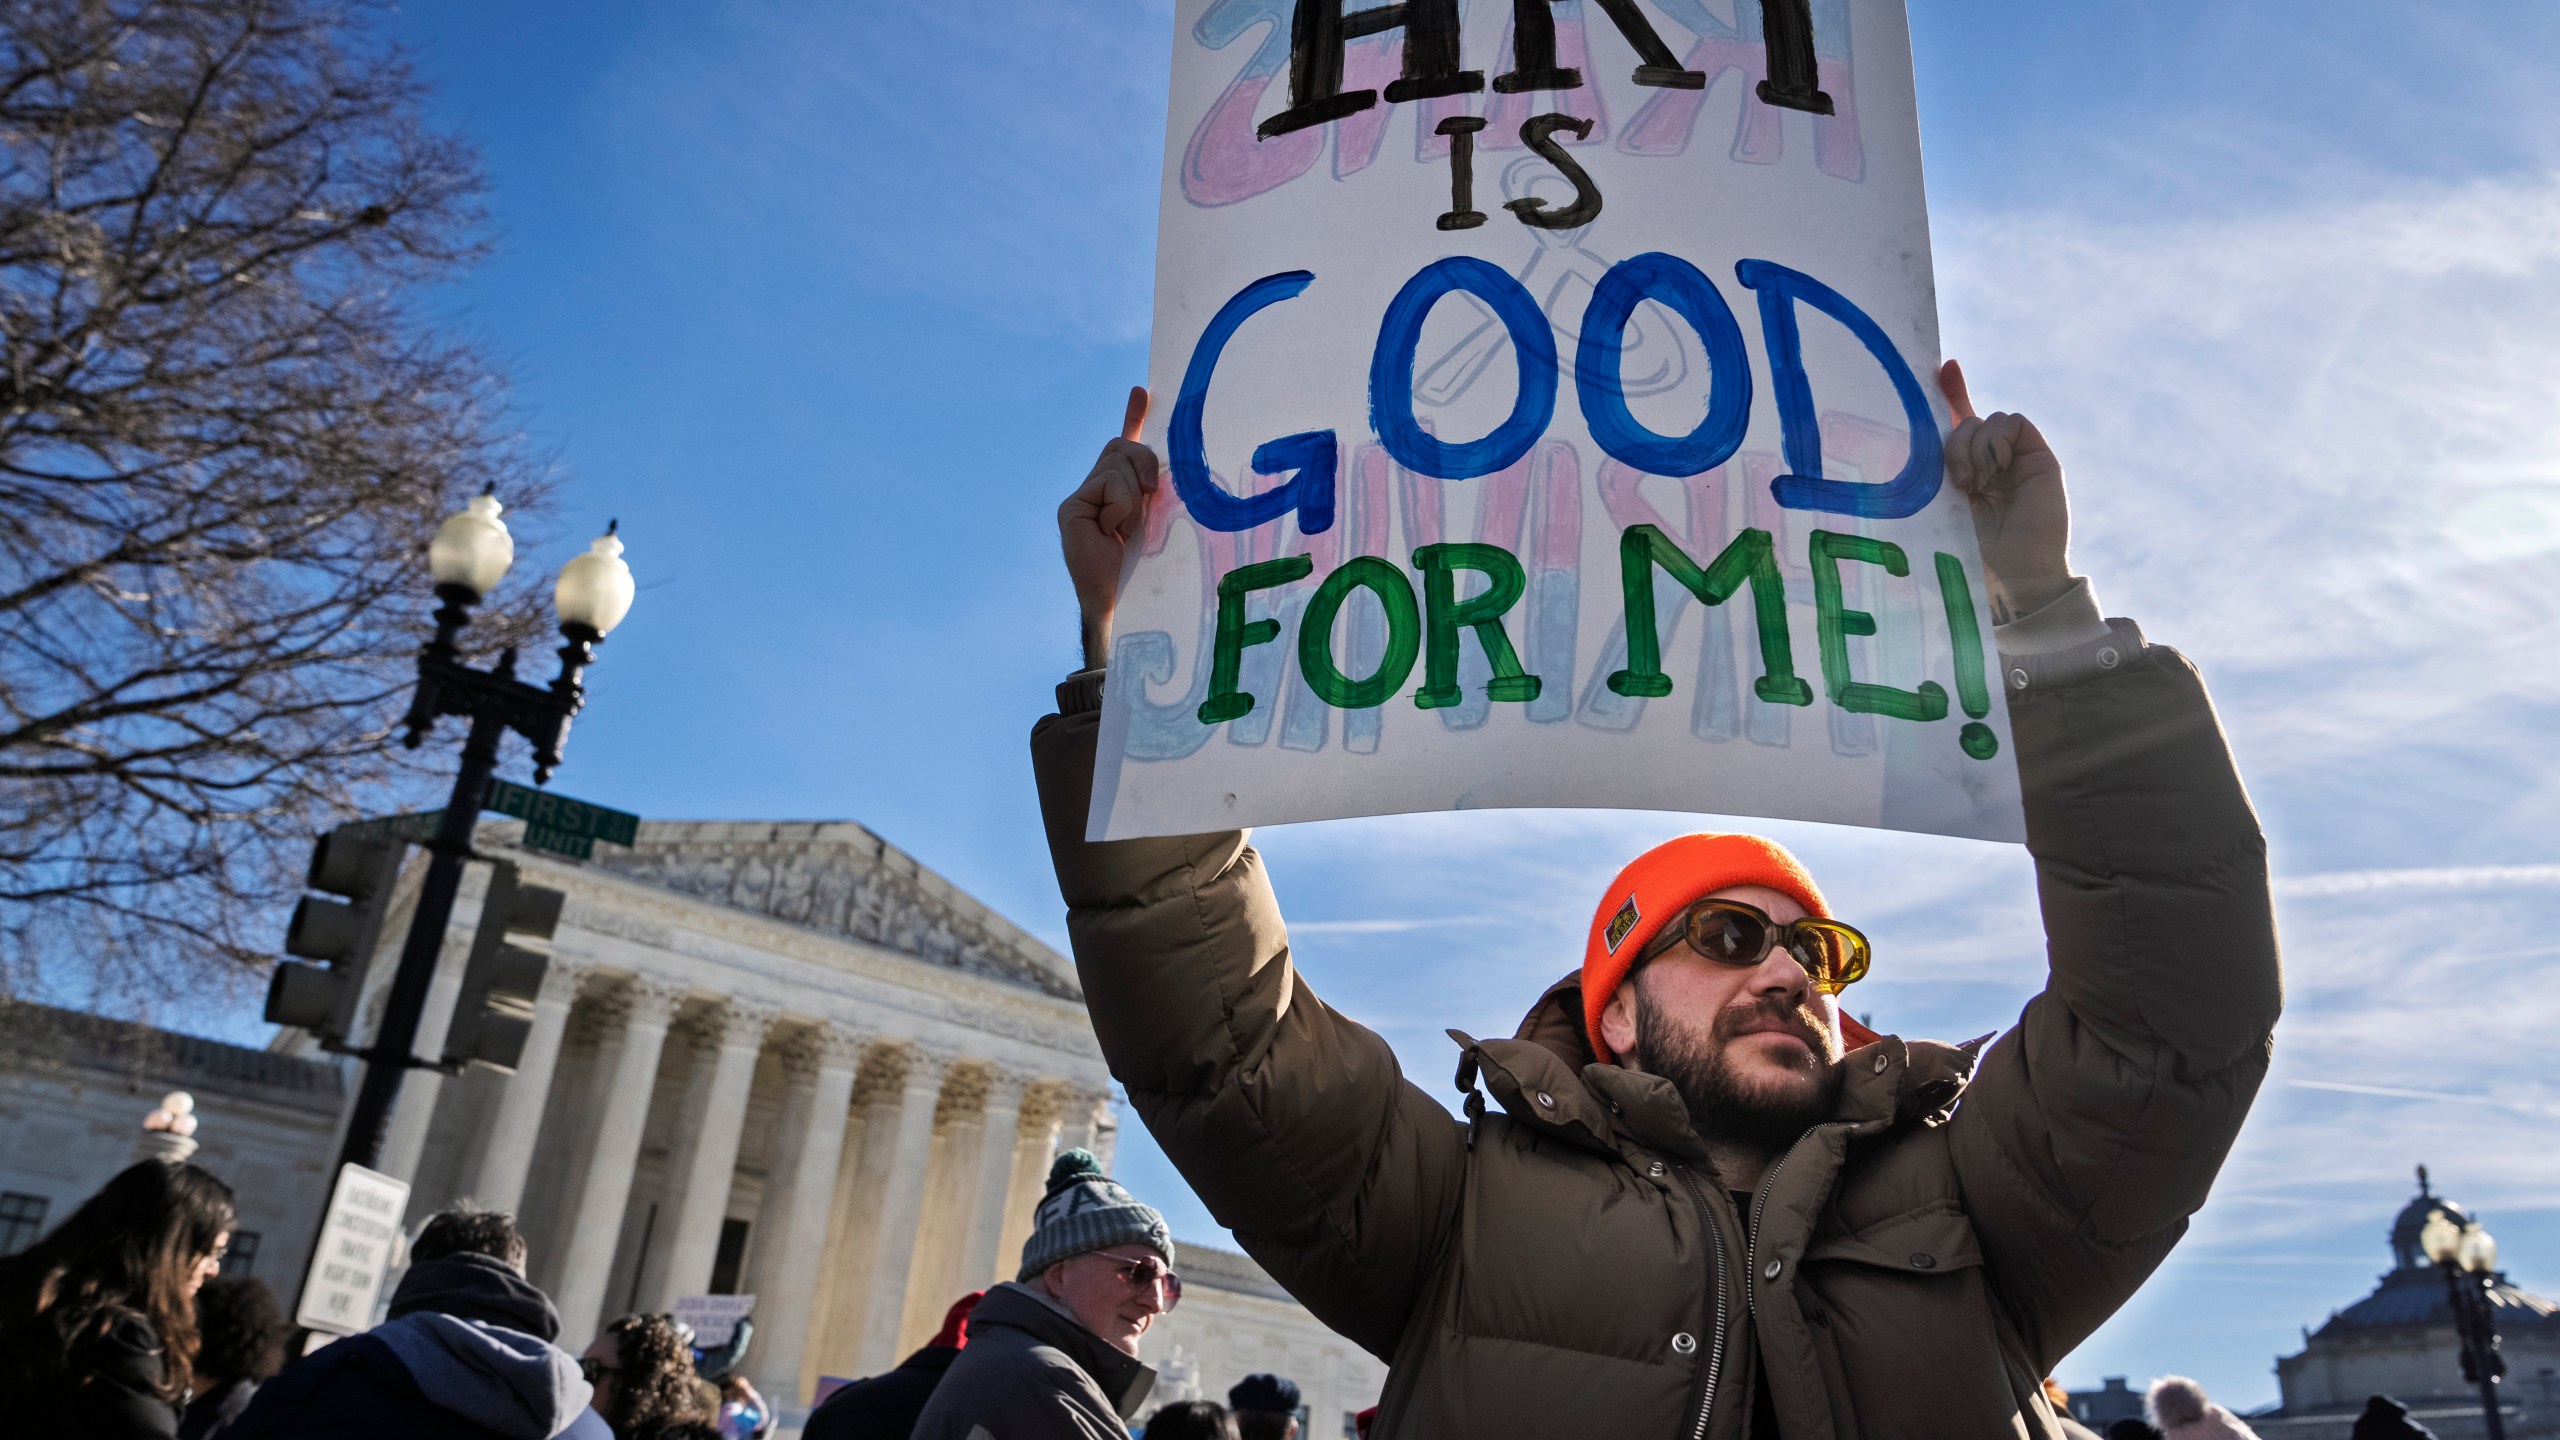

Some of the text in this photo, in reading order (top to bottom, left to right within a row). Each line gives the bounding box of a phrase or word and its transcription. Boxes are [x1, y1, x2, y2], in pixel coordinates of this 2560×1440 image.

[1436, 113, 1603, 231] IS
[1168, 251, 1945, 535] GOOD
[1198, 524, 1999, 761] FOR ME!
[499, 785, 606, 835] FIRST
[528, 822, 590, 858] UNIT
[1620, 911, 1638, 934] DAVIS
